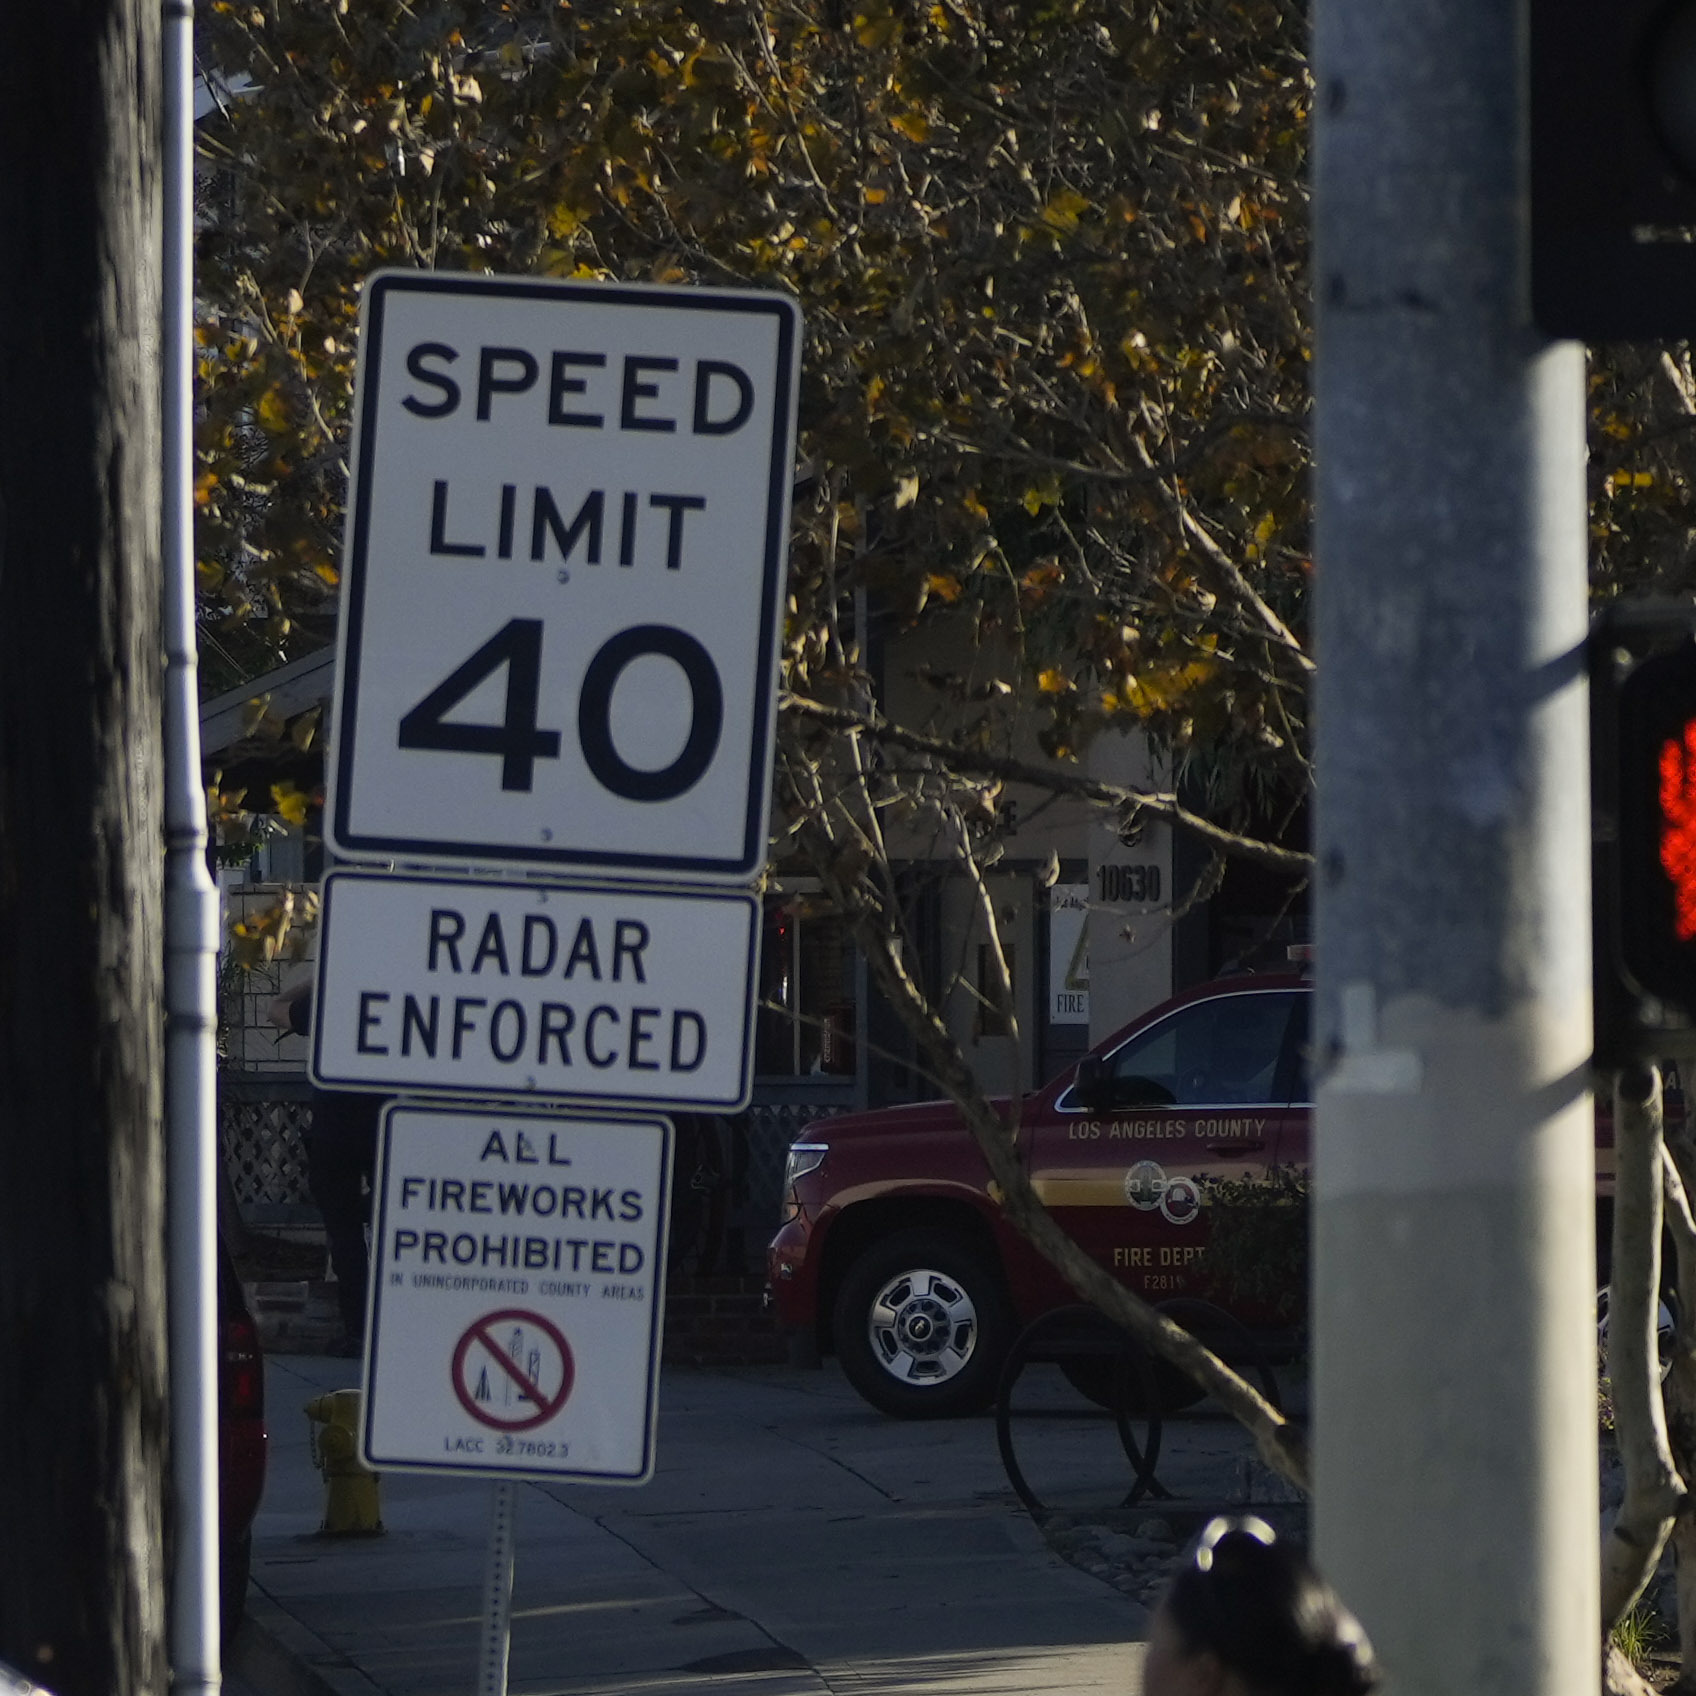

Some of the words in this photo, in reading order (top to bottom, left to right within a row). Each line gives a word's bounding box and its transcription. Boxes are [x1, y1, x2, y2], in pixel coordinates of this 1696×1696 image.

[402, 342, 755, 435] SPEED
[430, 480, 706, 570] LIMIT
[398, 617, 723, 803] 40
[427, 908, 651, 984] RADAR
[1057, 994, 1085, 1014] FIRE
[357, 991, 708, 1073] ENFORCED
[480, 1129, 572, 1167] ALL
[1069, 1121, 1101, 1139] LOS
[1110, 1120, 1186, 1139] ANGELES
[1195, 1118, 1266, 1138] COUNTY
[402, 1176, 644, 1222] FIREWORKS
[394, 1229, 645, 1275] PROHIBITED
[1114, 1247, 1153, 1267] FIRE
[413, 1274, 529, 1294] UNINCORPORATED
[539, 1281, 591, 1297] COUNTY
[602, 1284, 645, 1300] AREAS
